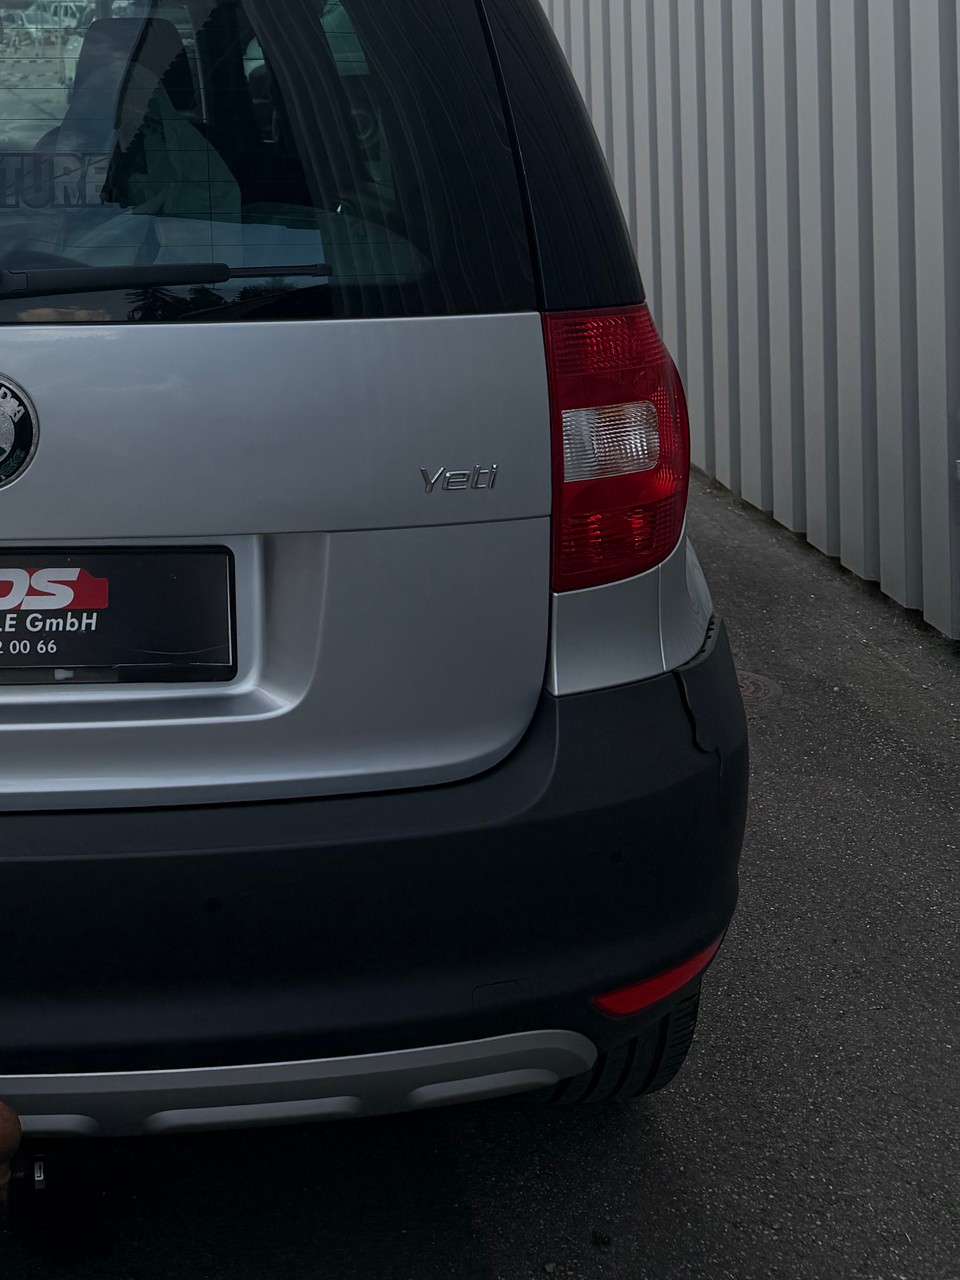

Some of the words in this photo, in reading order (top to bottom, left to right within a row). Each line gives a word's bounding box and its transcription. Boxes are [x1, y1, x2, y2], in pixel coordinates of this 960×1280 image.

[420, 463, 498, 493] Yeti
[25, 612, 98, 632] GmbH
[9, 640, 31, 654] 00
[36, 640, 57, 654] 66
